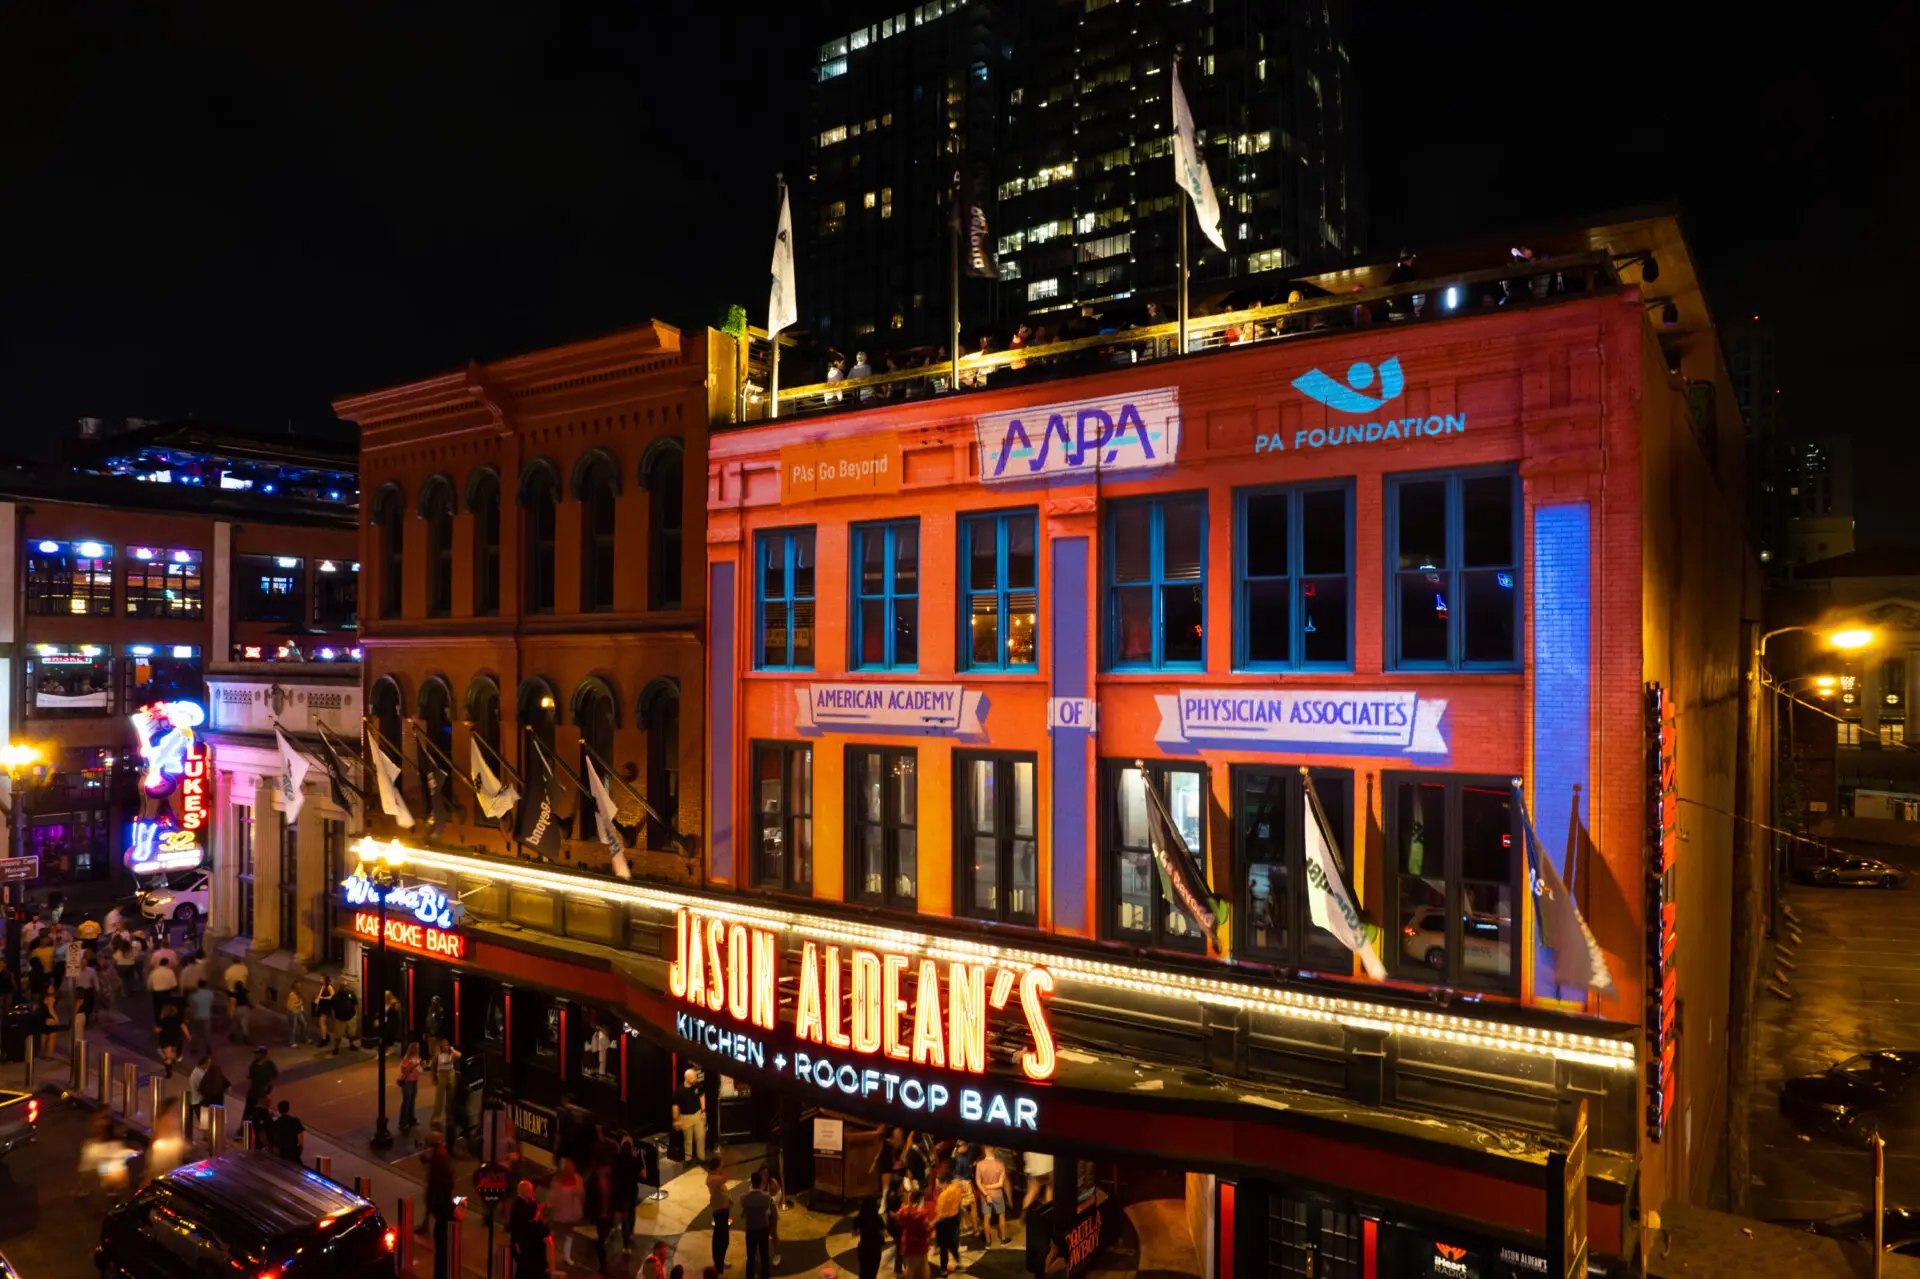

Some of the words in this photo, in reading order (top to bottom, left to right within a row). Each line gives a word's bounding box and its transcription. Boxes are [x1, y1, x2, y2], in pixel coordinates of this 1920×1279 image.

[990, 403, 1161, 476] AAPA
[1255, 434, 1284, 453] PA
[1295, 412, 1466, 449] FOUNDATION
[793, 465, 815, 484] PAs
[819, 462, 836, 481] Go
[839, 453, 888, 480] Beyond
[816, 689, 883, 709] AMERICAN
[888, 691, 955, 711] ACADEMY
[1059, 701, 1083, 725] OF
[1185, 698, 1281, 723] PHYSICIAN
[1289, 700, 1407, 727] ASSOCIATES
[158, 831, 196, 852] 32
[426, 928, 460, 958] BAR
[669, 907, 777, 1031] JASON
[795, 940, 1057, 1083] ALDEAN'S
[675, 1010, 765, 1069] KITCHEN
[794, 1052, 950, 1113] ROOFTOP
[959, 1088, 1038, 1131] BAR
[1434, 1255, 1467, 1273] iHeart
[1500, 1247, 1520, 1262] JASON
[1433, 1264, 1468, 1279] RADIO
